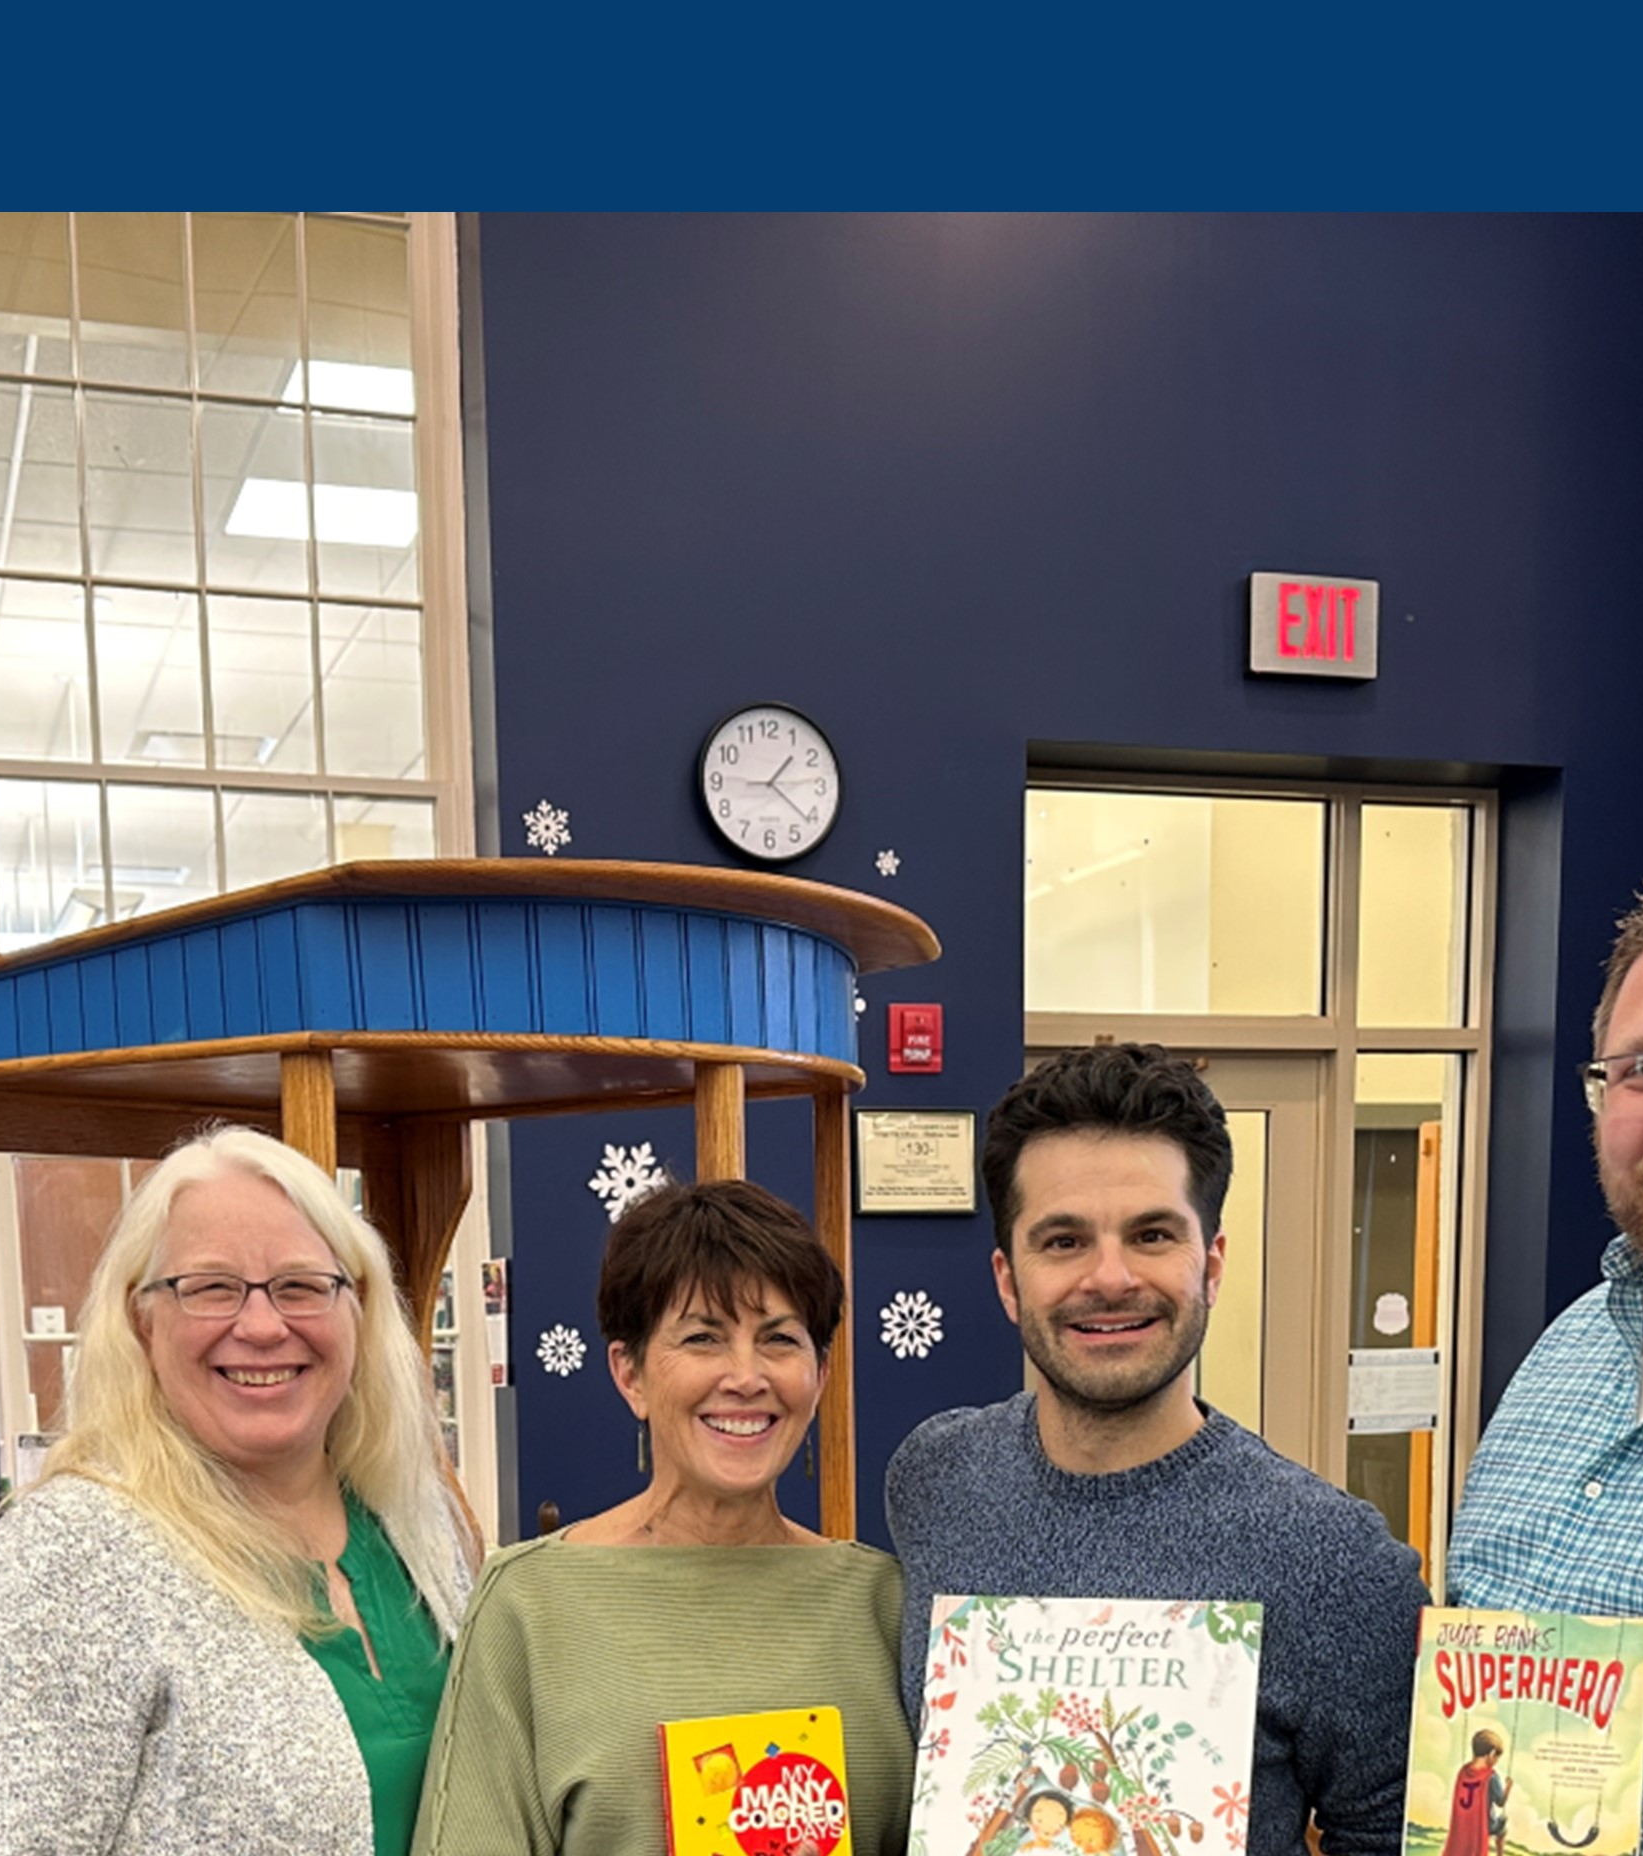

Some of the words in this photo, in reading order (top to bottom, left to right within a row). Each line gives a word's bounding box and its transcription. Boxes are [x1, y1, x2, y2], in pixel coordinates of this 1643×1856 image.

[1277, 581, 1362, 663] EXIT
[738, 724, 753, 744] 11
[759, 719, 778, 740] 12
[789, 727, 796, 746] 1
[720, 744, 738, 765] 10
[806, 749, 818, 767] 2
[710, 771, 723, 791] 9
[814, 778, 826, 796] 3
[719, 799, 731, 818] 8
[805, 805, 818, 824] 4
[739, 820, 750, 838] 7
[763, 829, 776, 849] 6
[788, 825, 801, 843] 5
[1023, 1624, 1056, 1645] the
[1059, 1621, 1172, 1654] perfect
[1437, 1622, 1484, 1647] JUDE
[1493, 1628, 1555, 1651] BANKS
[997, 1645, 1189, 1690] SHELTER
[1434, 1649, 1625, 1730] SUPERHERO
[781, 1764, 817, 1785] MY
[740, 1778, 831, 1810] MANY
[786, 1825, 845, 1843] DAYS
